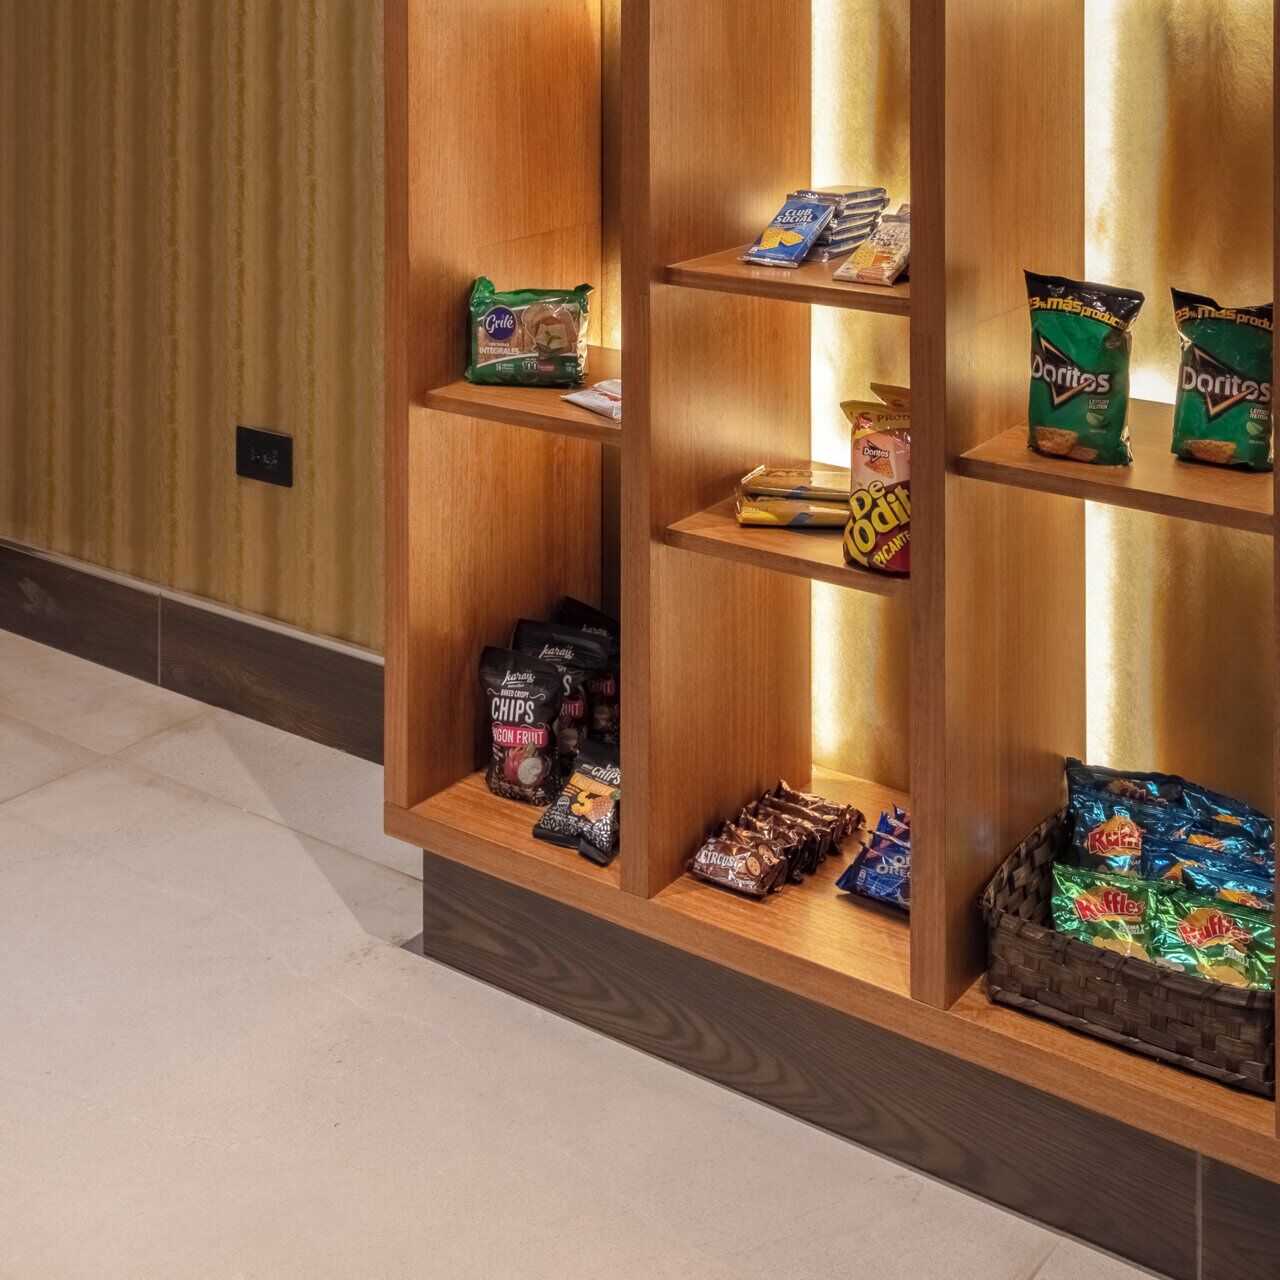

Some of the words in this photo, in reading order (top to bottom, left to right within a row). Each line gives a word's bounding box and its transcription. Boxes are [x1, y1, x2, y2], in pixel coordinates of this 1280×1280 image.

[774, 215, 814, 224] SOCIAL
[1047, 296, 1083, 313] más
[485, 314, 515, 334] Grilé
[1236, 313, 1273, 331] produ
[479, 346, 520, 355] INTEGRALES
[1032, 354, 1111, 393] Doritos
[1182, 366, 1271, 402] Doritos
[863, 447, 890, 459] Doritos
[849, 480, 886, 520] De
[491, 696, 535, 723] CHIPS
[516, 730, 544, 745] FRUIT
[591, 767, 621, 785] CHIPS
[699, 849, 738, 869] CIRCUS
[1073, 889, 1146, 923] Ruffles
[1177, 912, 1252, 949] Ruffles
